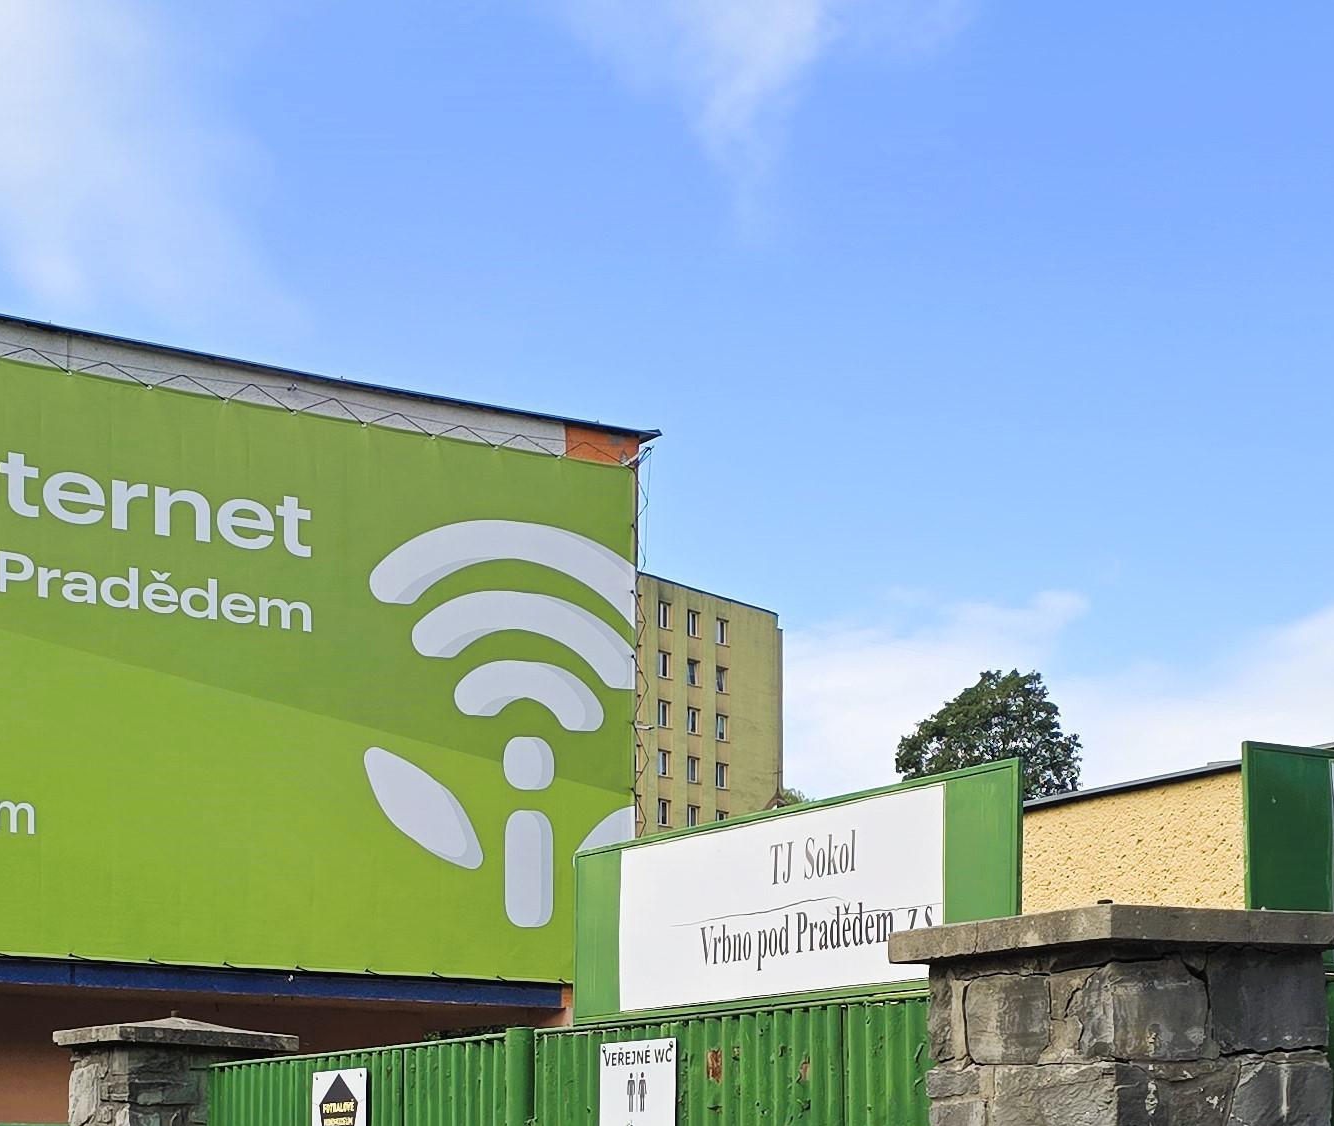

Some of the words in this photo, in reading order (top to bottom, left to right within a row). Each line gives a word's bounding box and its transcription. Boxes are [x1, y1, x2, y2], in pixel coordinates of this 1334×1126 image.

[770, 841, 794, 885] TJ
[804, 829, 856, 880] Sokol
[700, 924, 752, 966] Vrbno
[757, 914, 789, 971] pod
[796, 901, 894, 953] Pradědem
[604, 1044, 651, 1067] VEŘEJNÉ
[654, 1047, 673, 1064] WC
